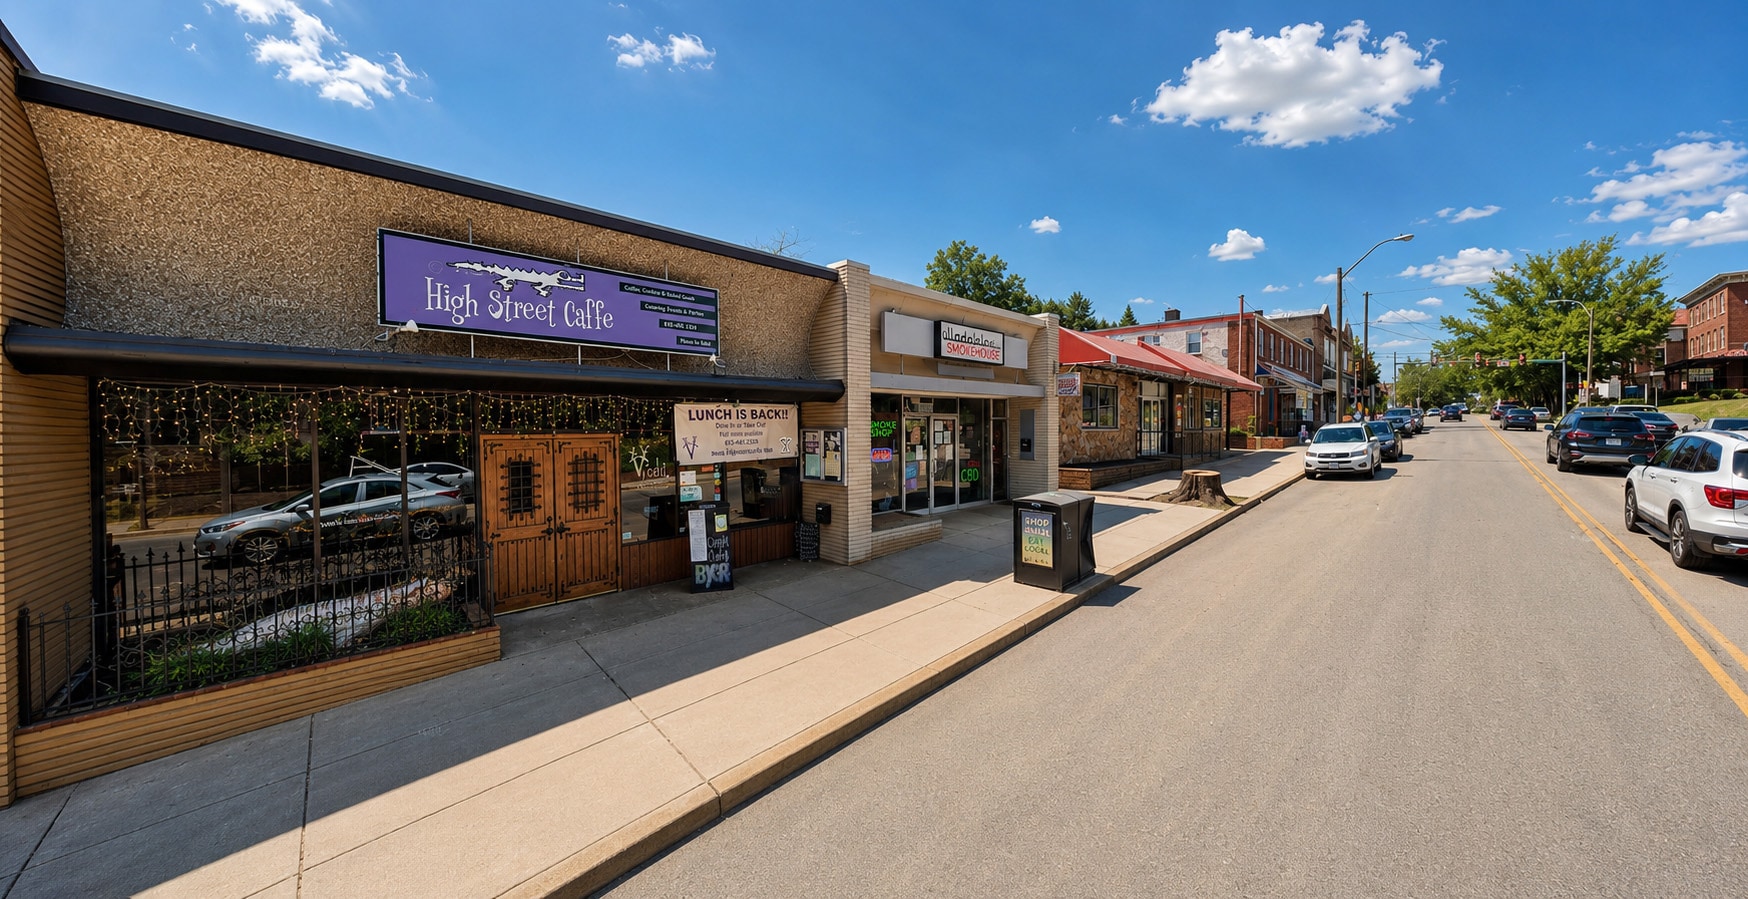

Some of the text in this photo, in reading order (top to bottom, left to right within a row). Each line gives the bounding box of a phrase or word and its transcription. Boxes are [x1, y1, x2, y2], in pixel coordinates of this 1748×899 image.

[425, 276, 614, 330] High Street Caffe
[946, 341, 1000, 361] SMOKEHOUSE
[688, 408, 789, 421] LUNCH IS BACK!!
